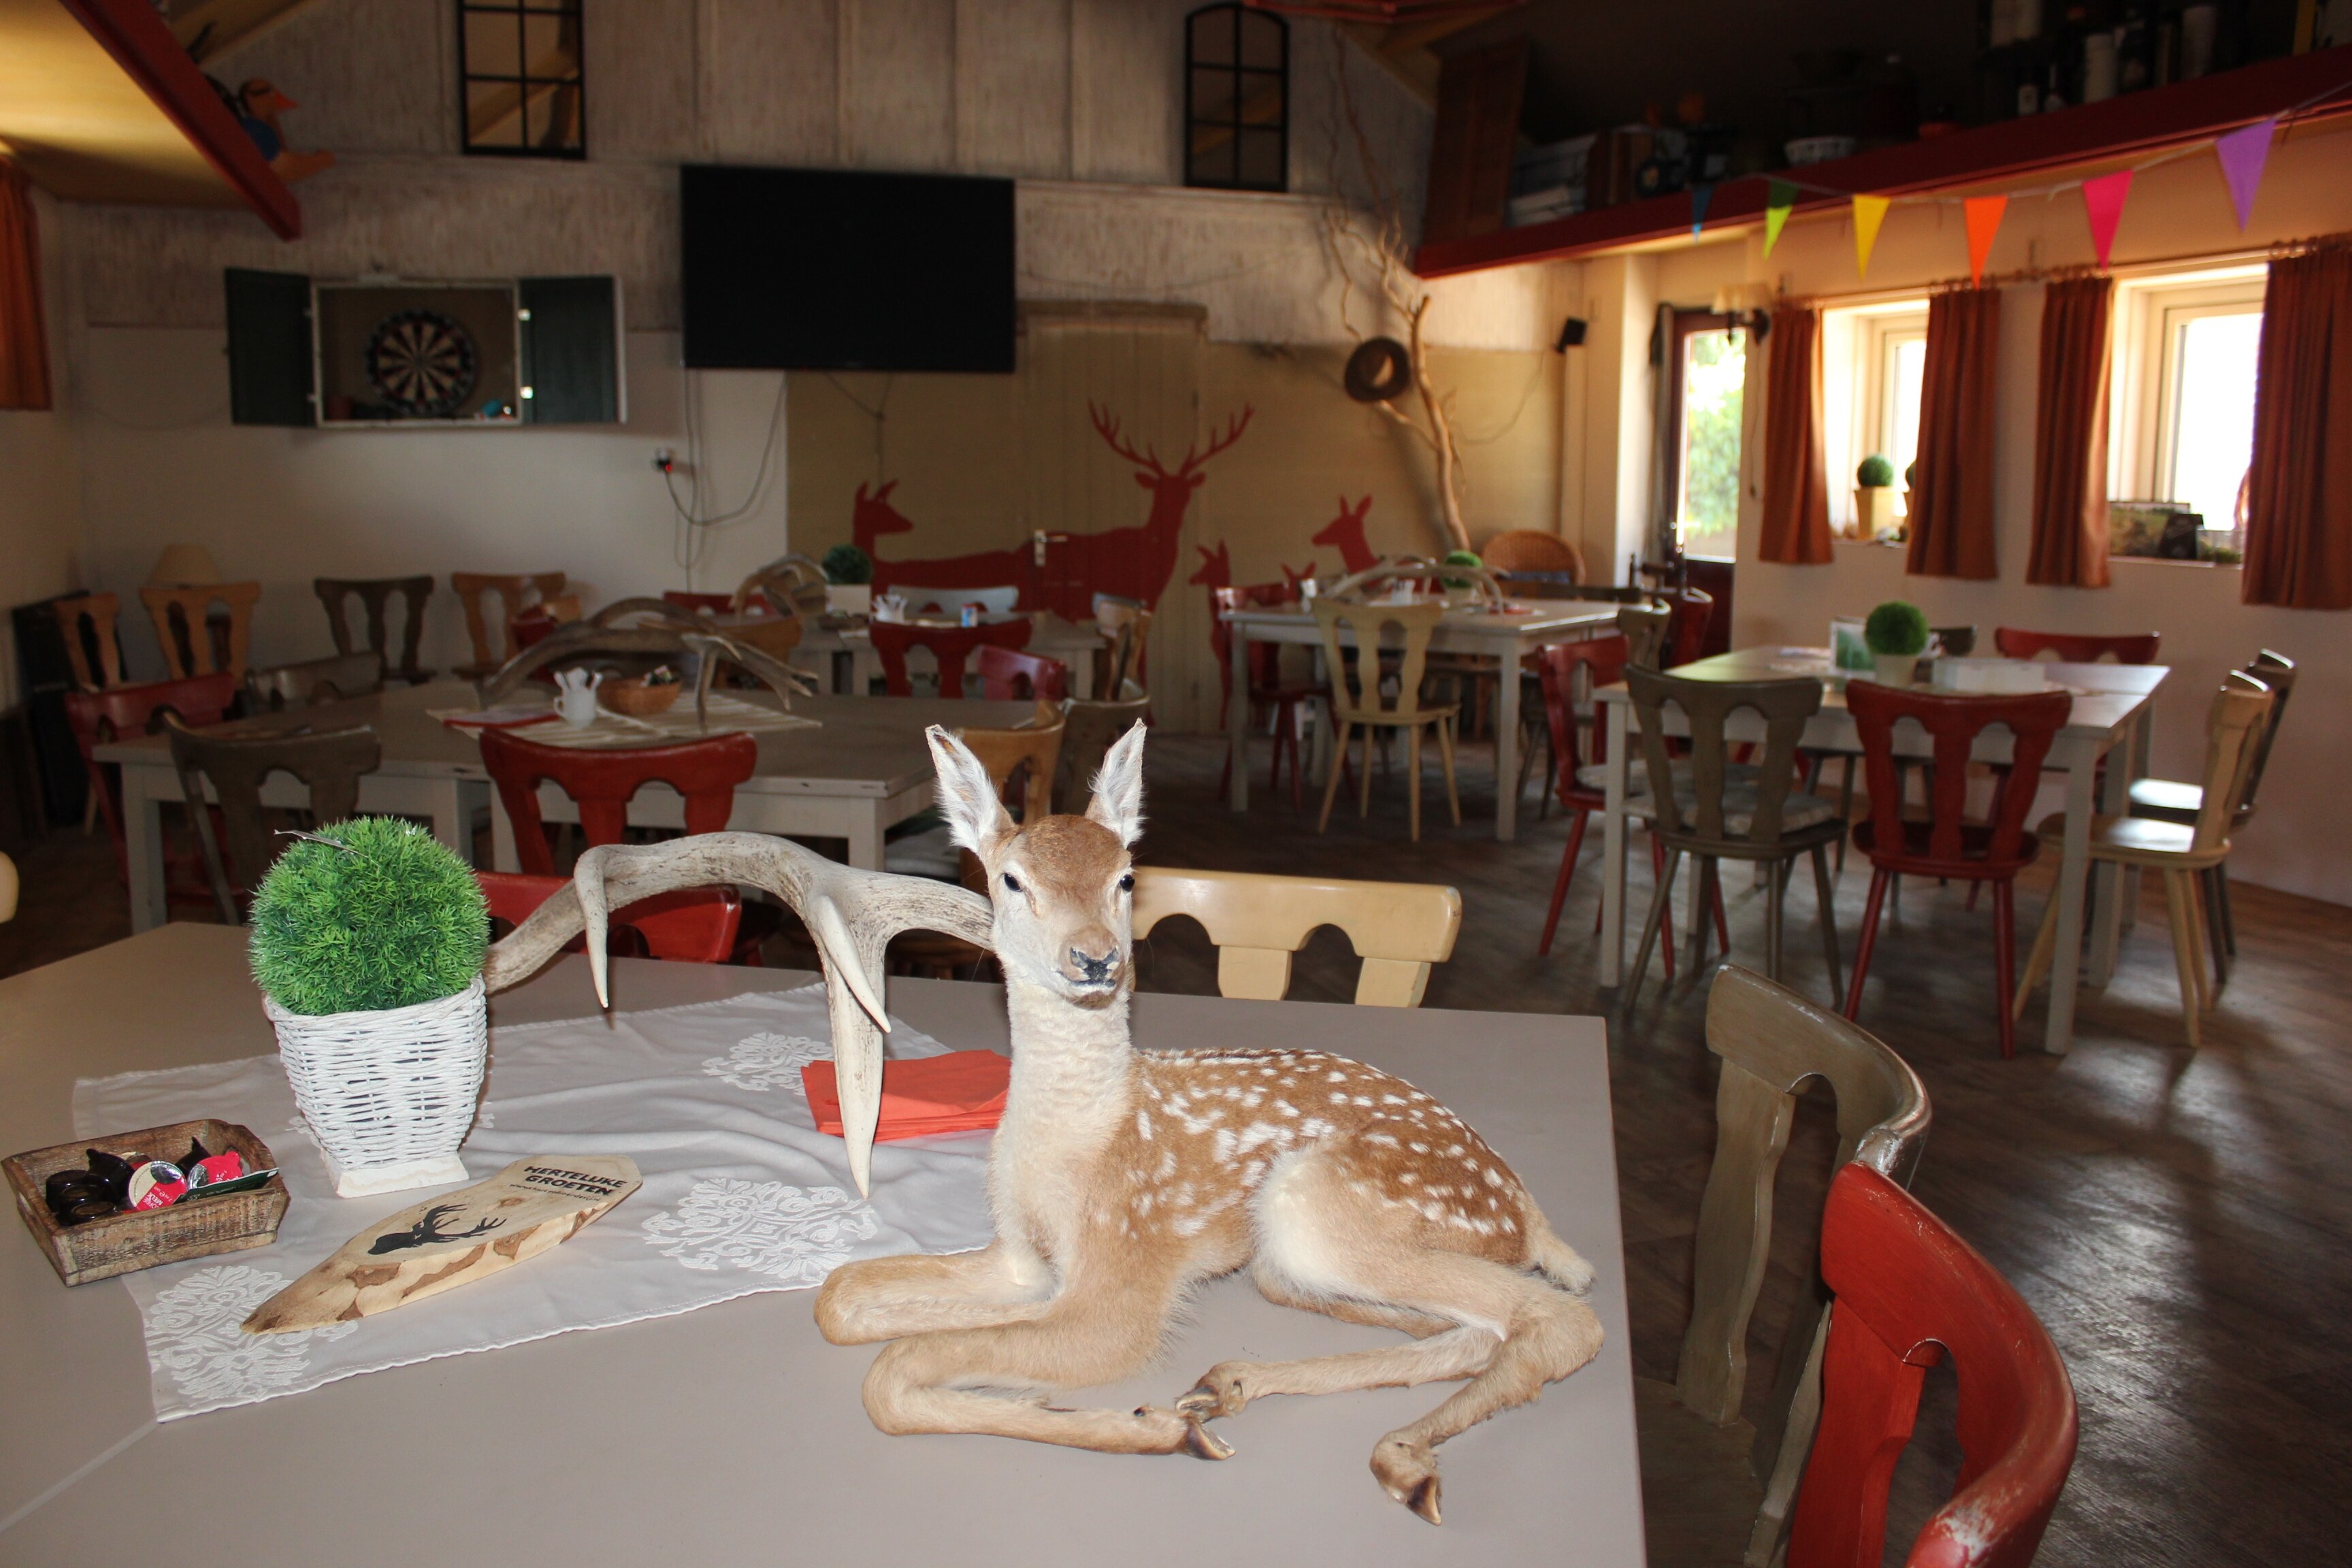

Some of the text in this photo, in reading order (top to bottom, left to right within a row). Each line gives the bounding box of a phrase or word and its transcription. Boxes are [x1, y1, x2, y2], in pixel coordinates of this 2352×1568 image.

[523, 1166, 627, 1188] HERTELIJKE
[525, 1175, 615, 1196] GROETEN
[148, 1192, 163, 1206] MELK
